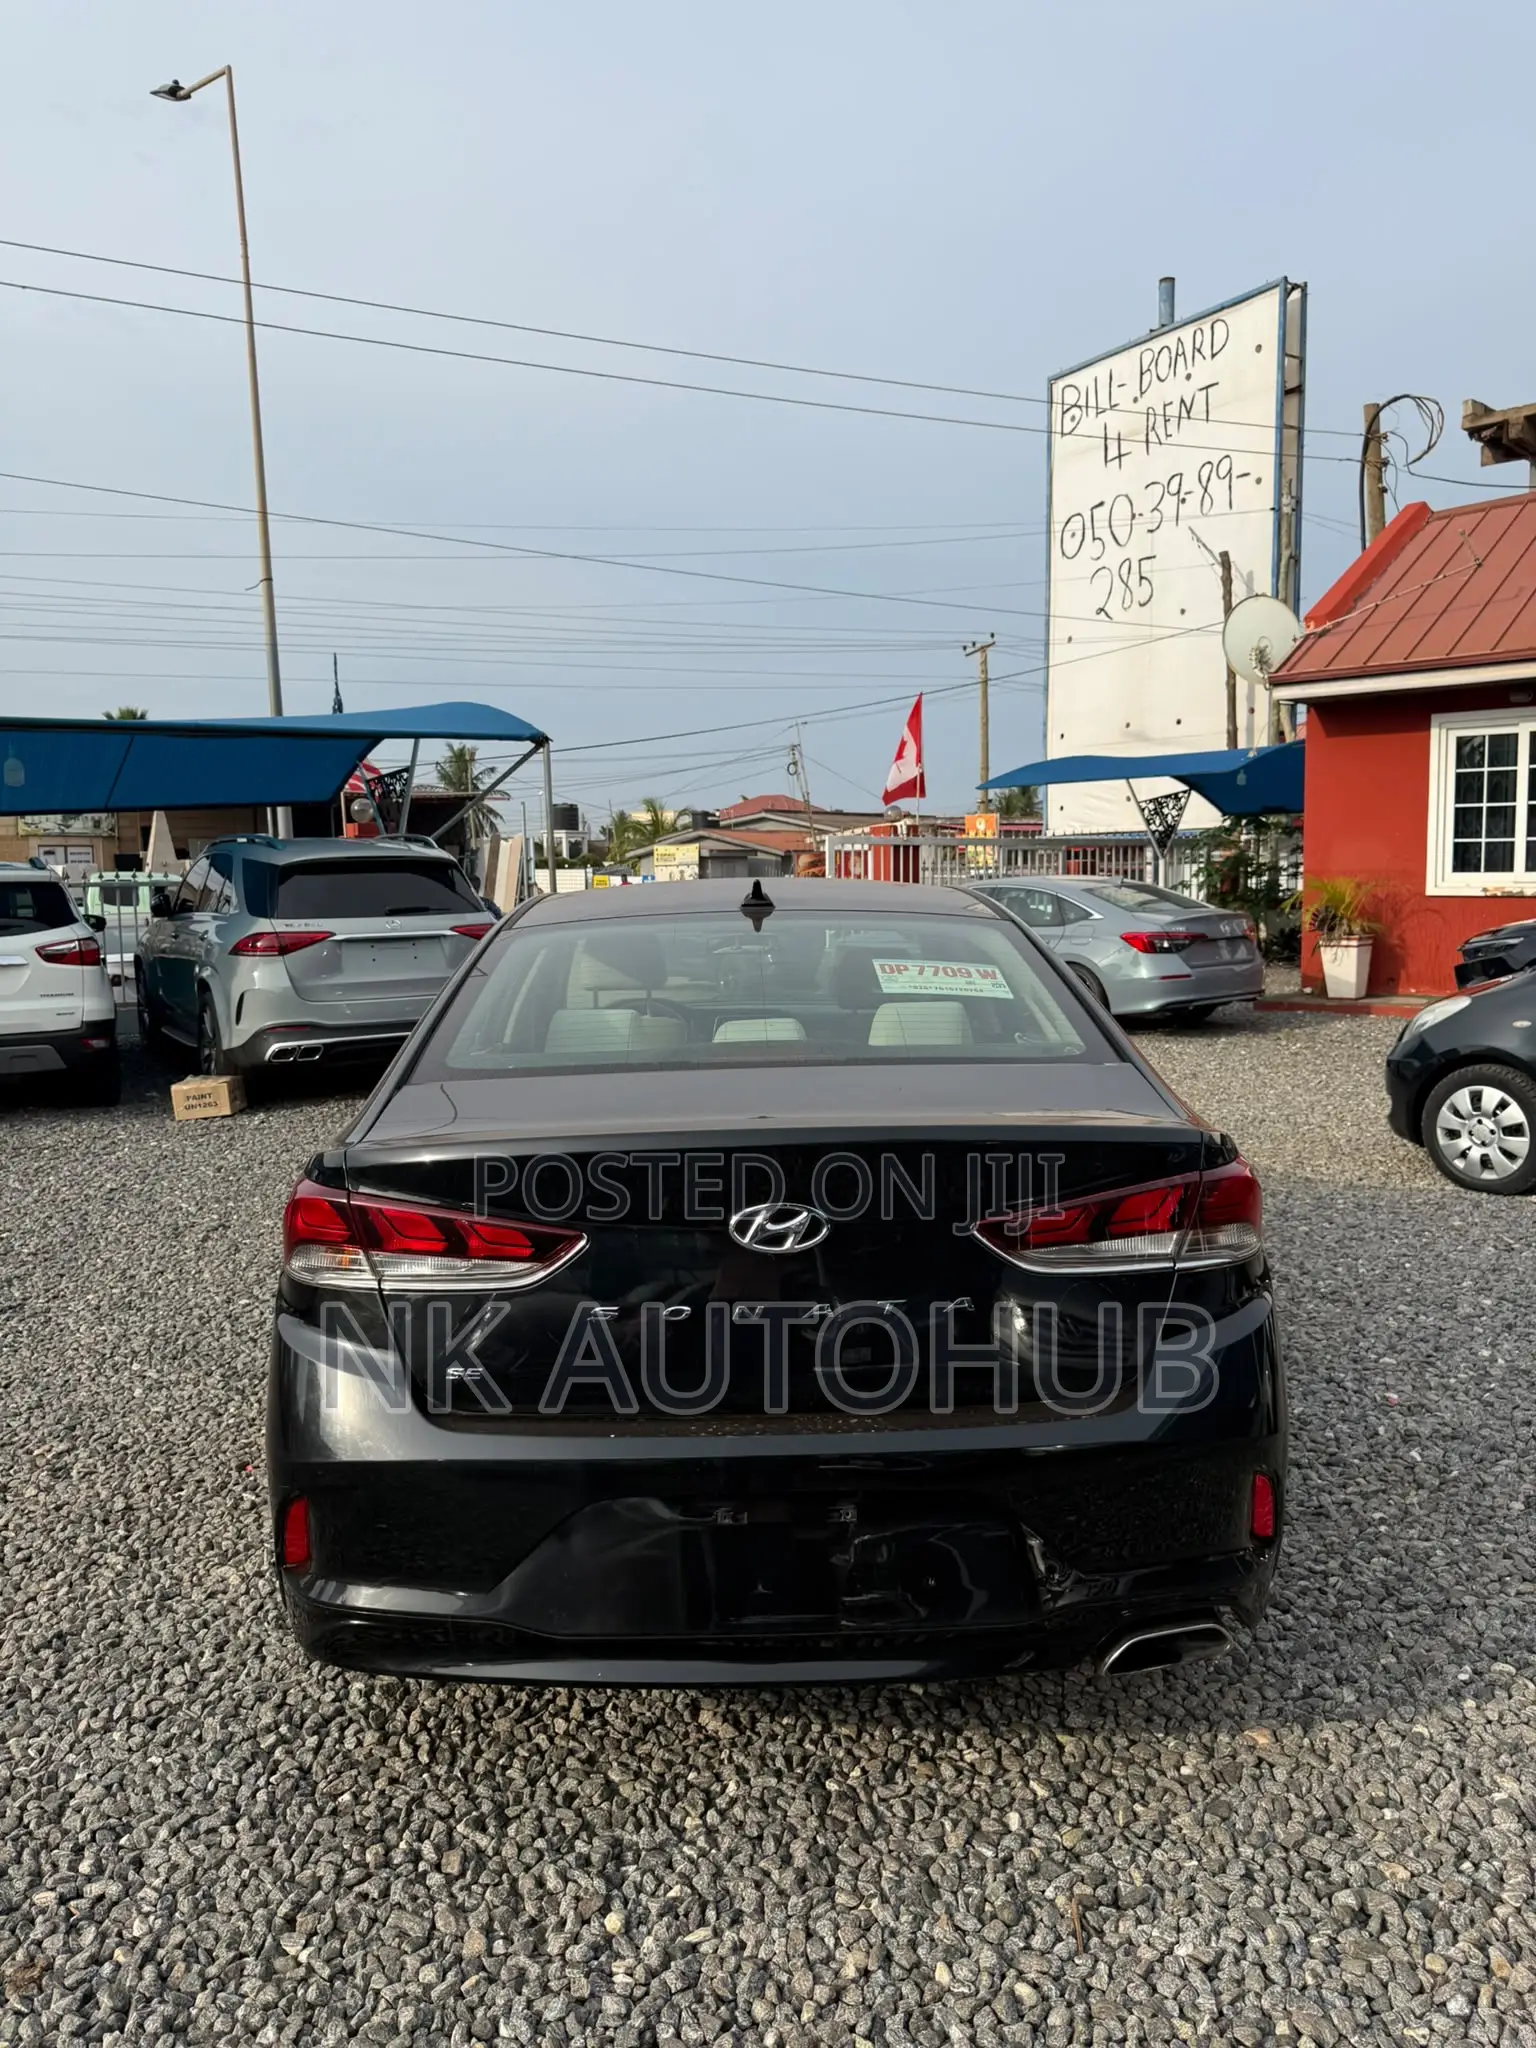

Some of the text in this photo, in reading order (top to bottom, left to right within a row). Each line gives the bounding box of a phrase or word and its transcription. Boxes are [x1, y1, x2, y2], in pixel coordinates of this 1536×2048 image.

[1103, 381, 1220, 470] 4 RENT
[1089, 554, 1157, 621] 285
[878, 963, 999, 980] DP 7709 W
[186, 1092, 213, 1102] PAINT
[587, 1297, 975, 1321] SONATA
[445, 1367, 483, 1380] SE
